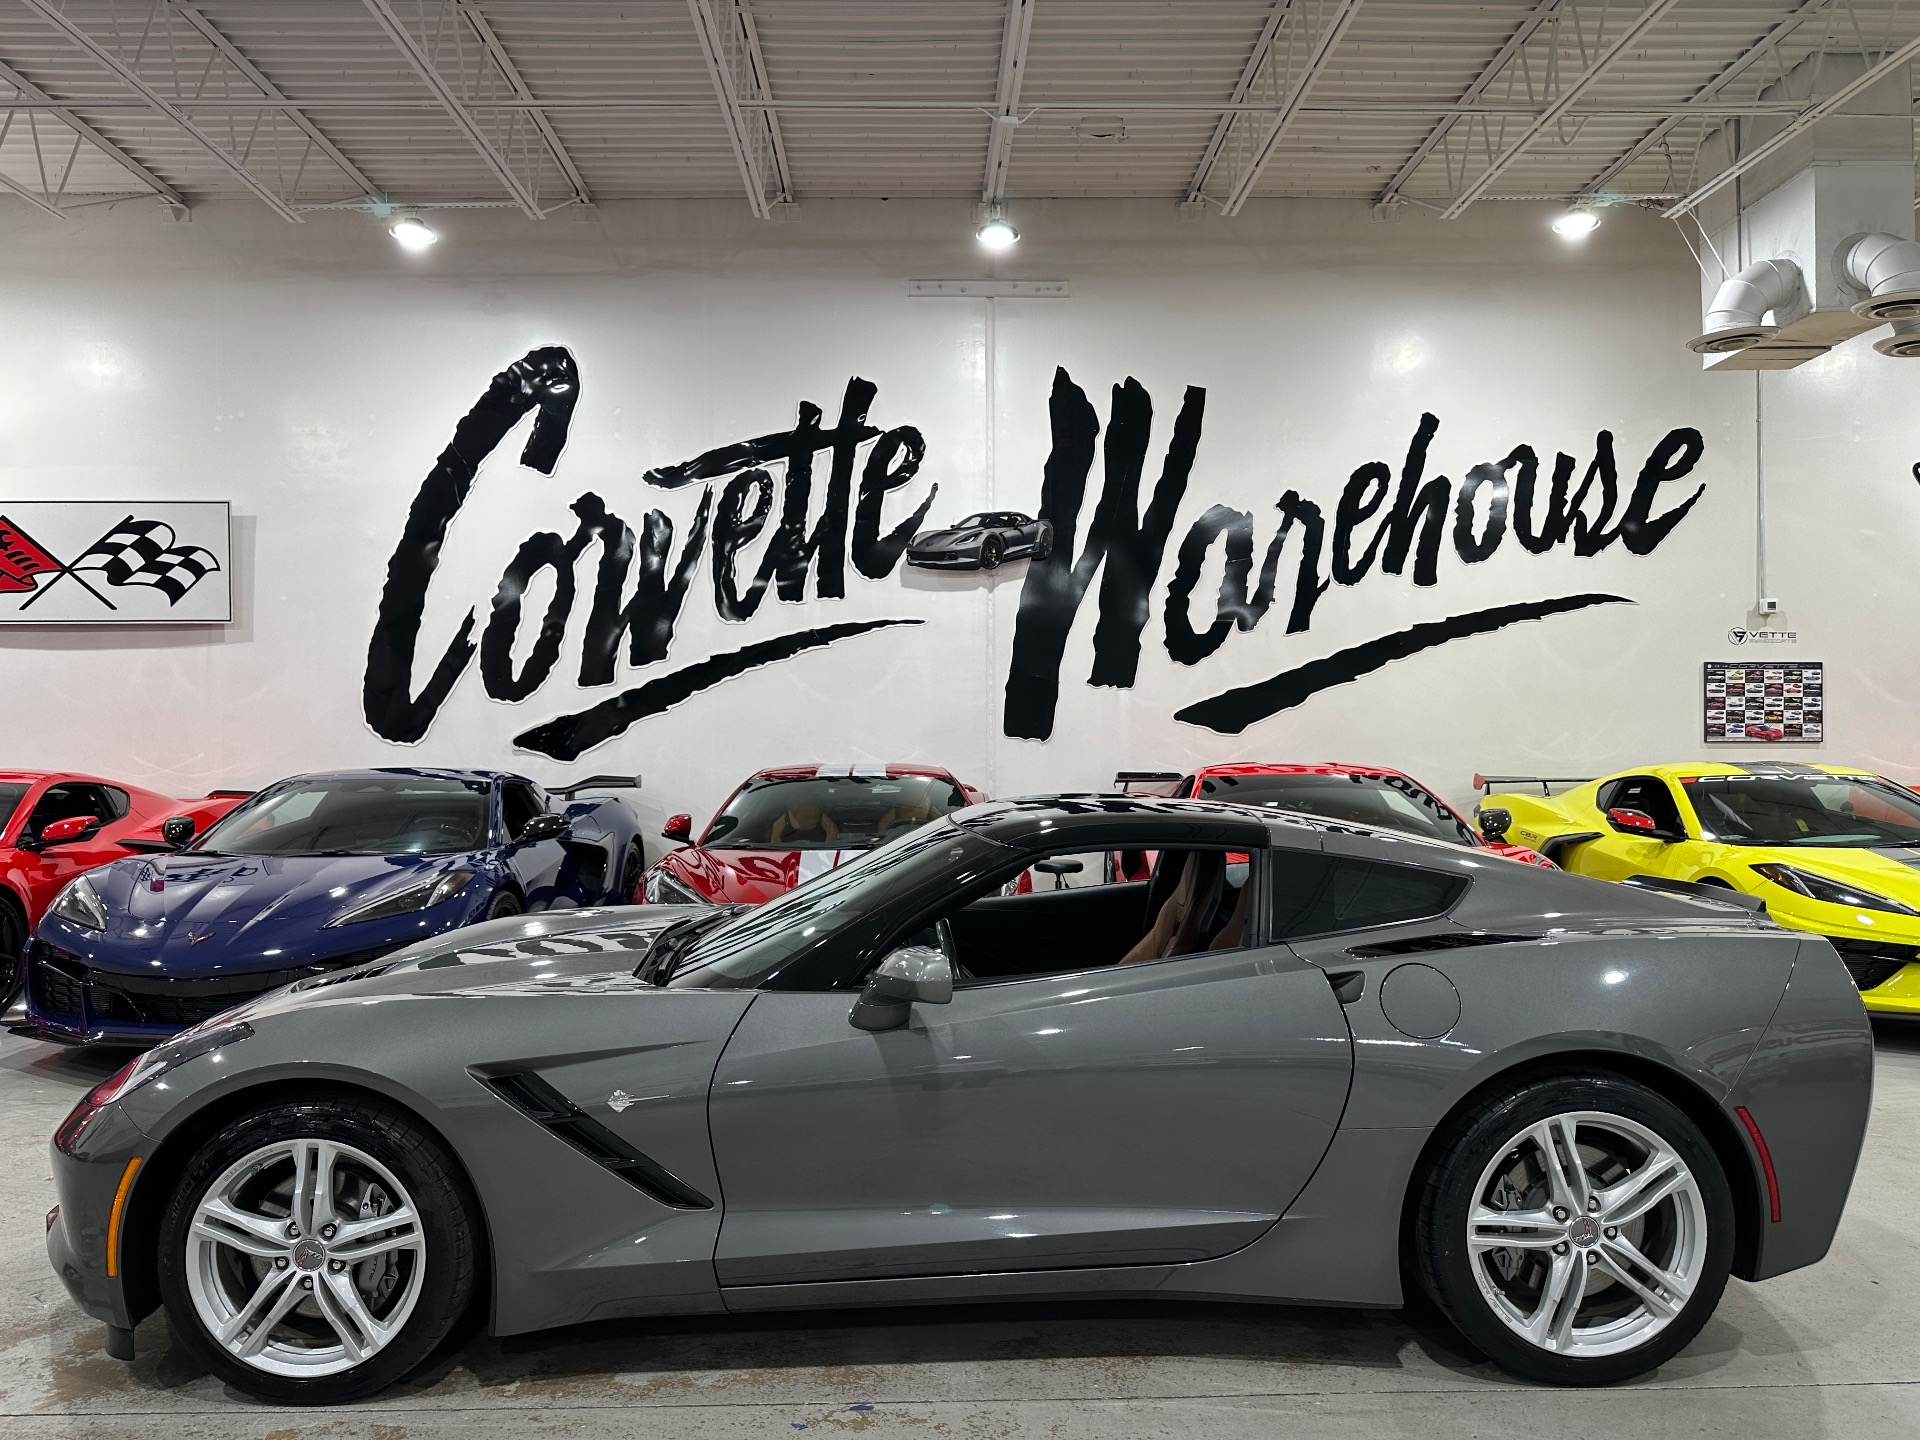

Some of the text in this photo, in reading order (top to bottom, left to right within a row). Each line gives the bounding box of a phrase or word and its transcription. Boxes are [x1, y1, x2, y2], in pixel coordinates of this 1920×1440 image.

[363, 346, 1706, 745] Corvette Warehouse
[1749, 631, 1797, 639] VETTE
[1698, 774, 1877, 783] CORVETTE
